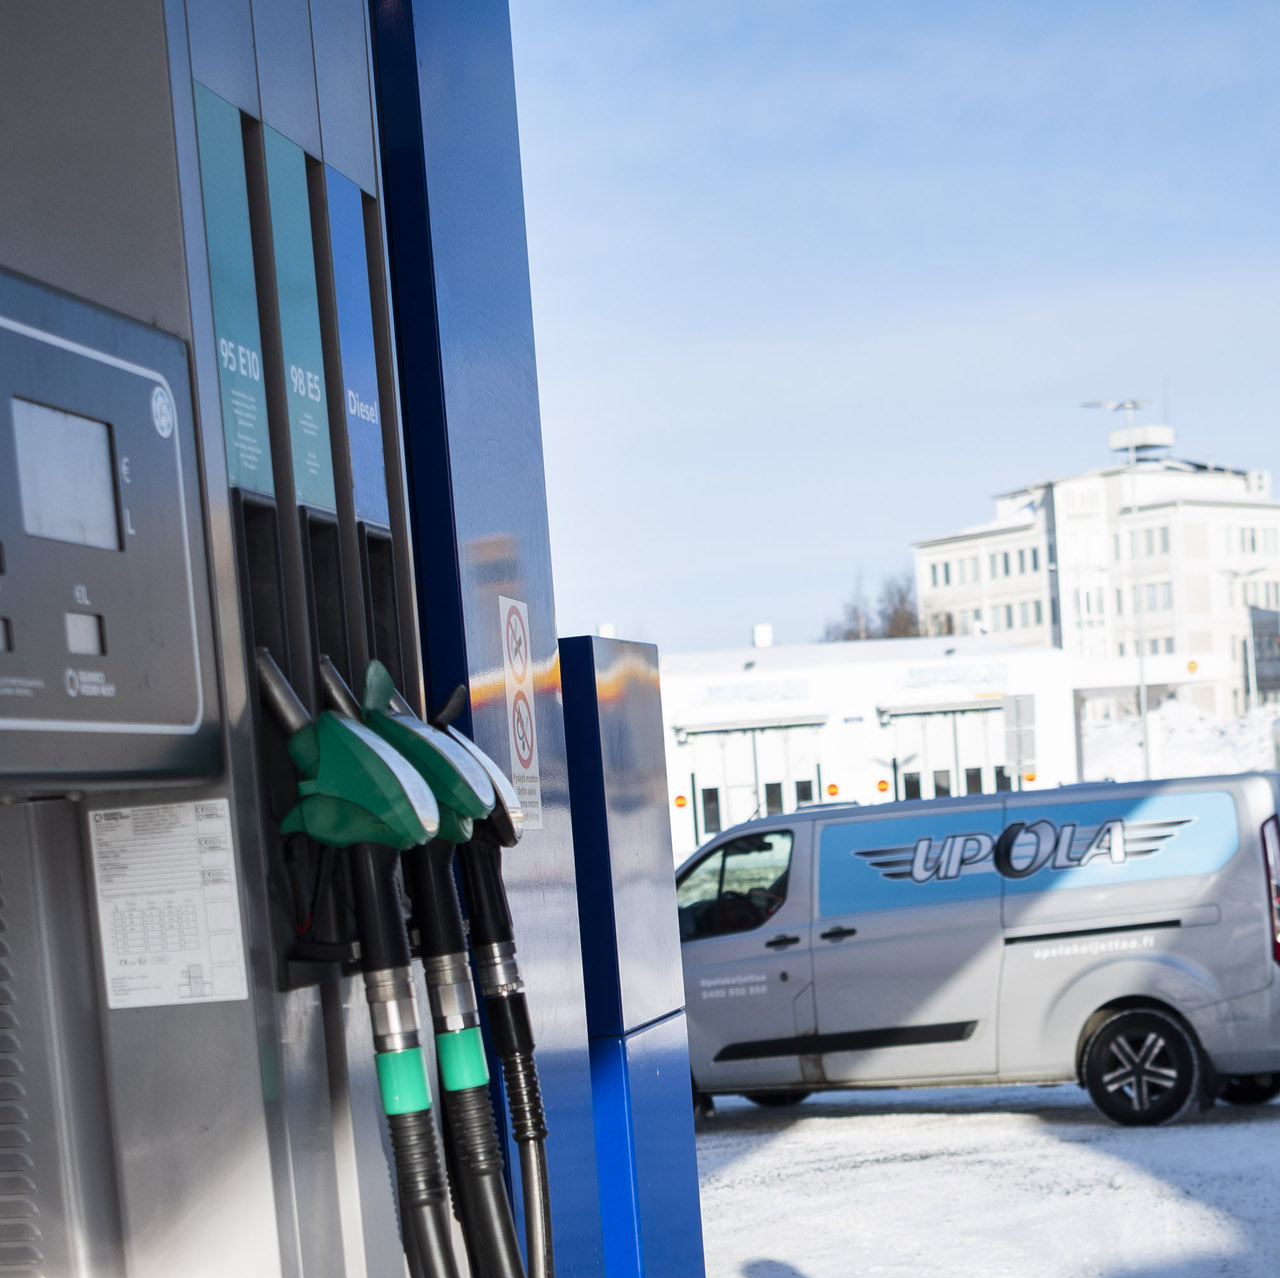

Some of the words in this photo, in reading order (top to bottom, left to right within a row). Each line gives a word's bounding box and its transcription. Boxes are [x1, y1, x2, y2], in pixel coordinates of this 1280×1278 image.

[220, 338, 237, 373] 95
[237, 344, 260, 382] E10
[290, 364, 306, 397] 98
[306, 371, 321, 403] E5
[347, 389, 379, 425] Diesel
[909, 819, 1126, 884] UPOLA
